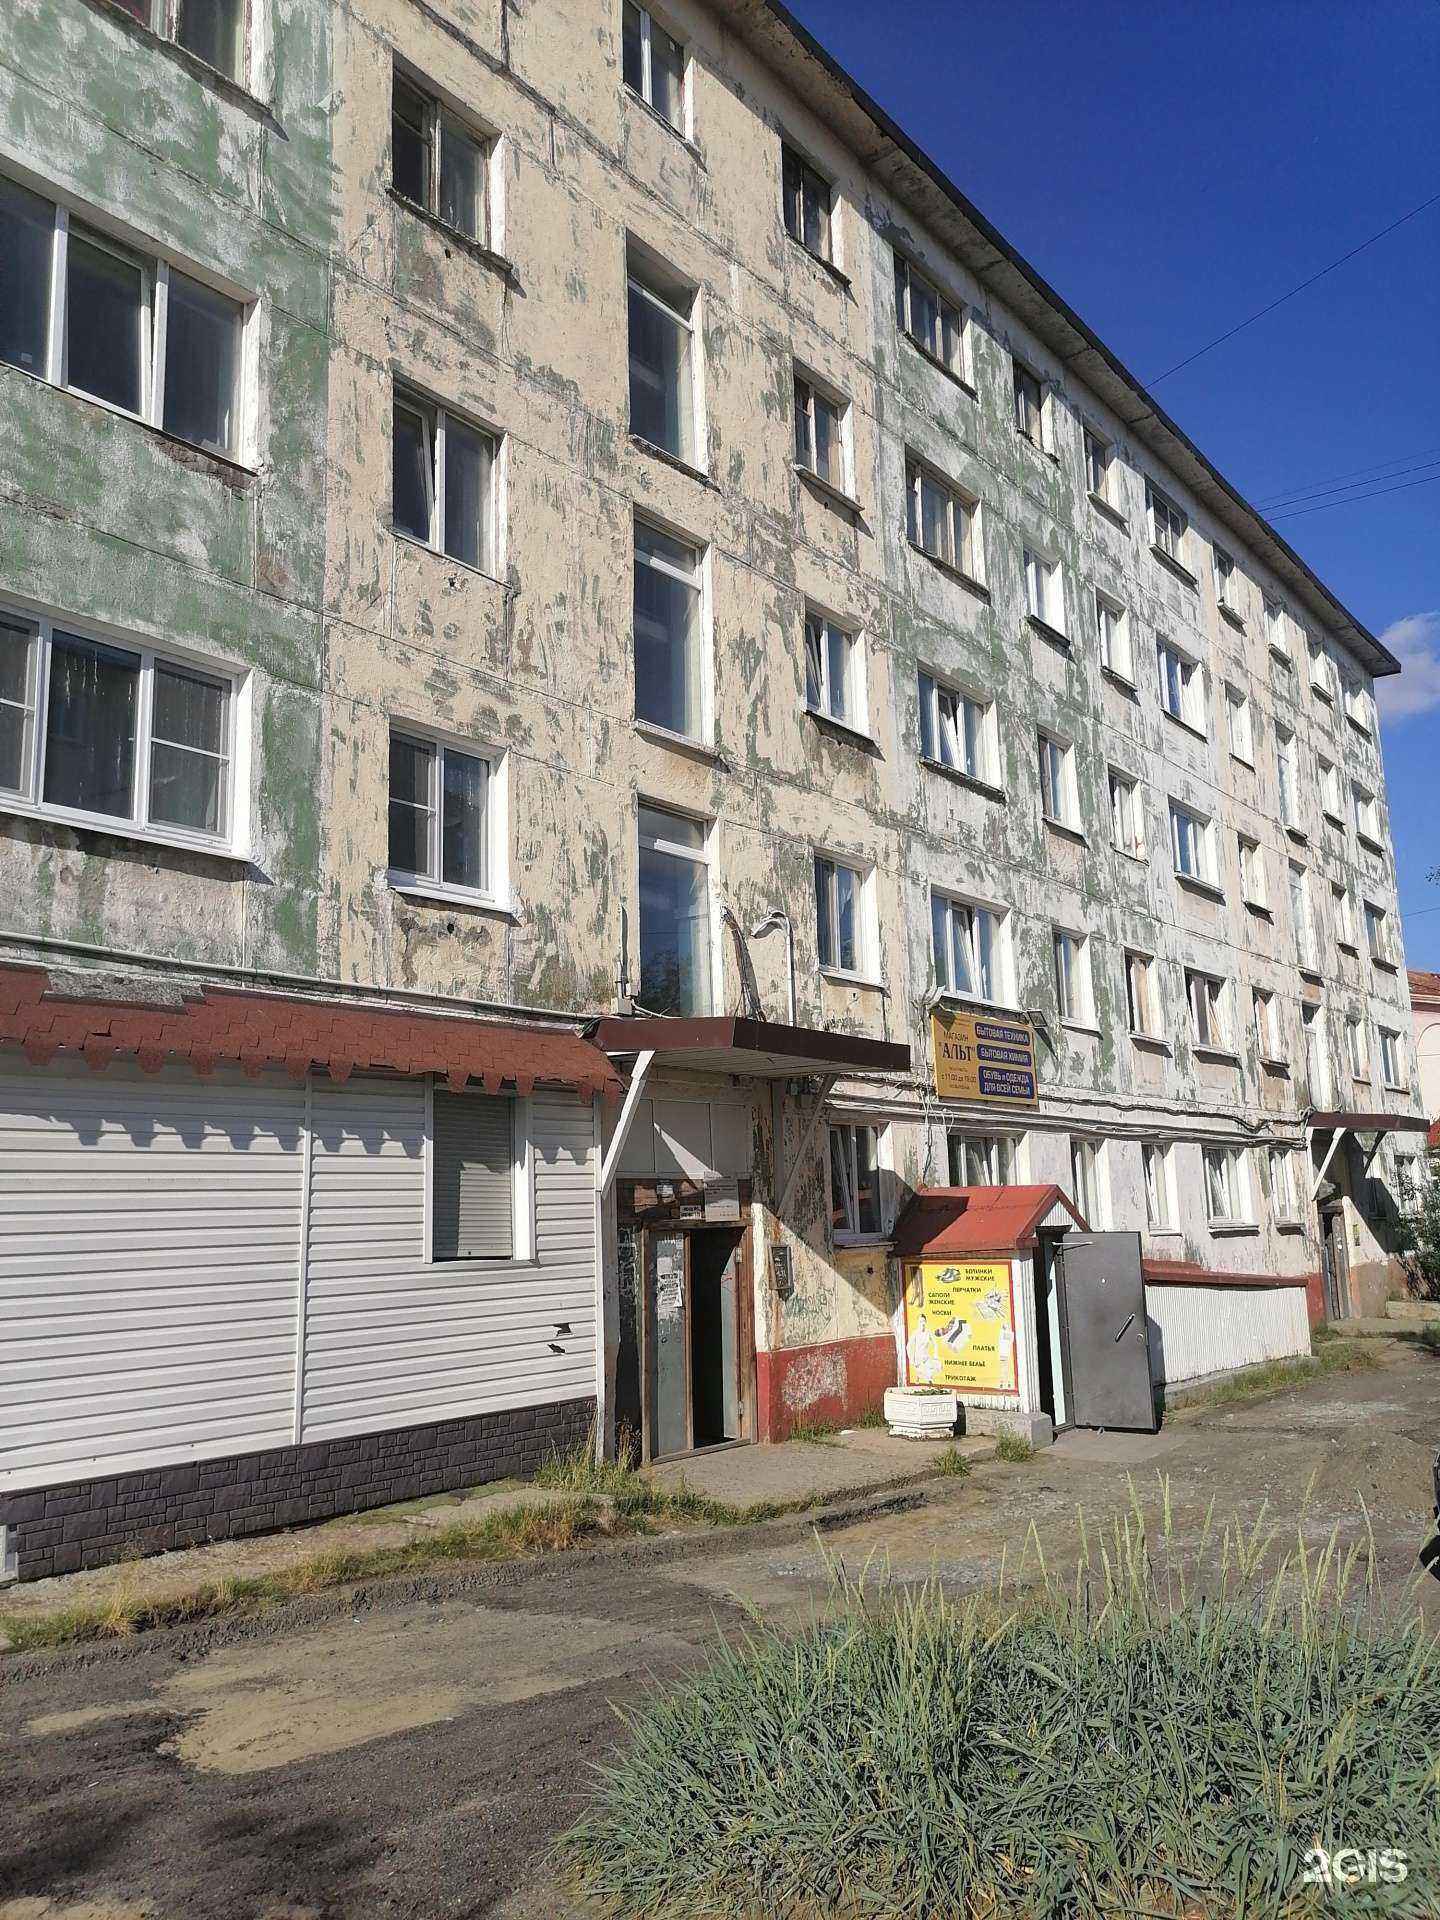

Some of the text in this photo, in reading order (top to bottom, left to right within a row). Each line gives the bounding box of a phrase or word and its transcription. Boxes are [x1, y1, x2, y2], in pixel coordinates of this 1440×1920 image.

[943, 1031, 969, 1041] МАГАЗИН
[976, 1026, 1029, 1043] БЫТОВАЯ ТЕХНИКА
[980, 1047, 1007, 1060] БЫТОВАЯ
[983, 1070, 1001, 1081] ОБУВЬ
[1006, 1073, 1029, 1084] ОДЕЖДА
[984, 1082, 995, 1093] ДЛЯ
[996, 1083, 1010, 1094] ВСЕЙ
[944, 1359, 968, 1367] НИЖНЕЕ
[944, 1374, 977, 1382] ТРИКОТАЖ
